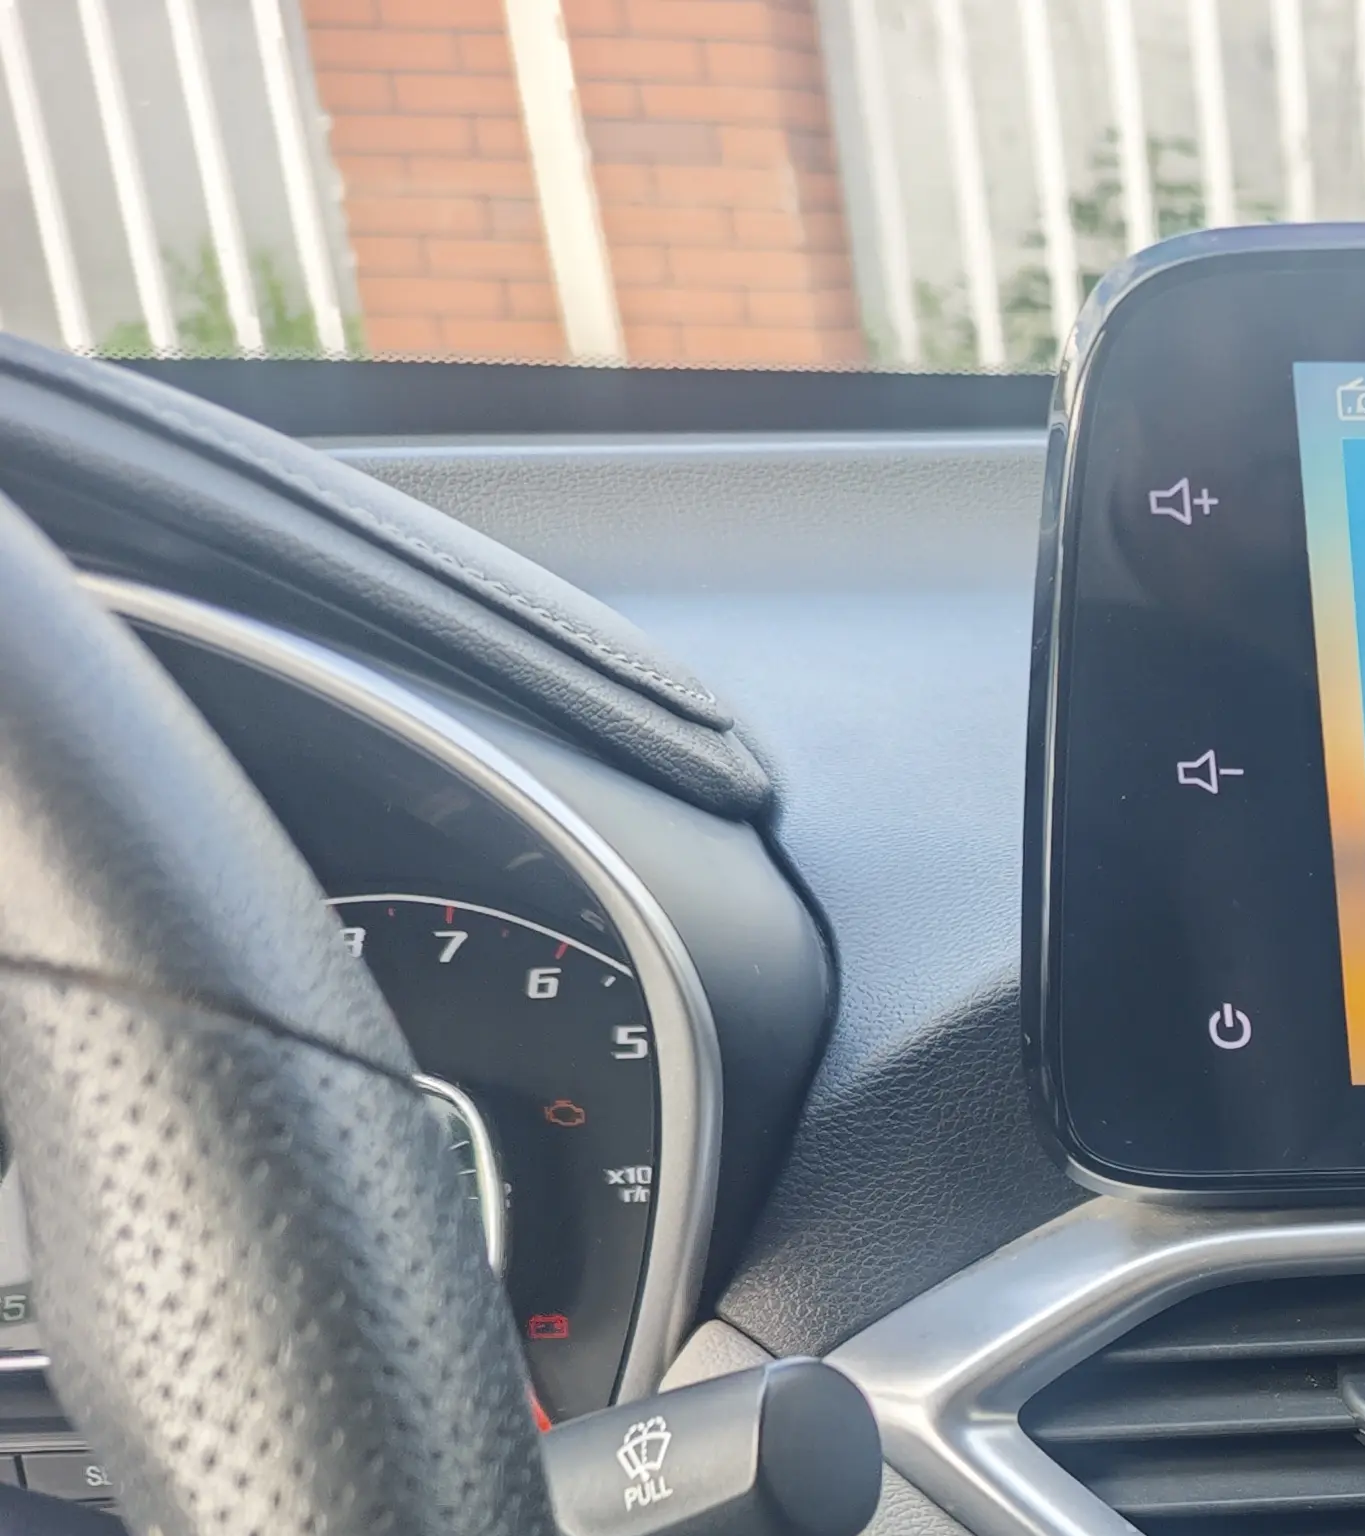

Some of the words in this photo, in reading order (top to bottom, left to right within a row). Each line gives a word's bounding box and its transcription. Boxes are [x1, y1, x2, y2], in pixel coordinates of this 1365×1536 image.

[434, 930, 468, 963] 7
[526, 966, 562, 999] 6
[610, 1025, 648, 1060] 5
[624, 1476, 674, 1512] PULL
